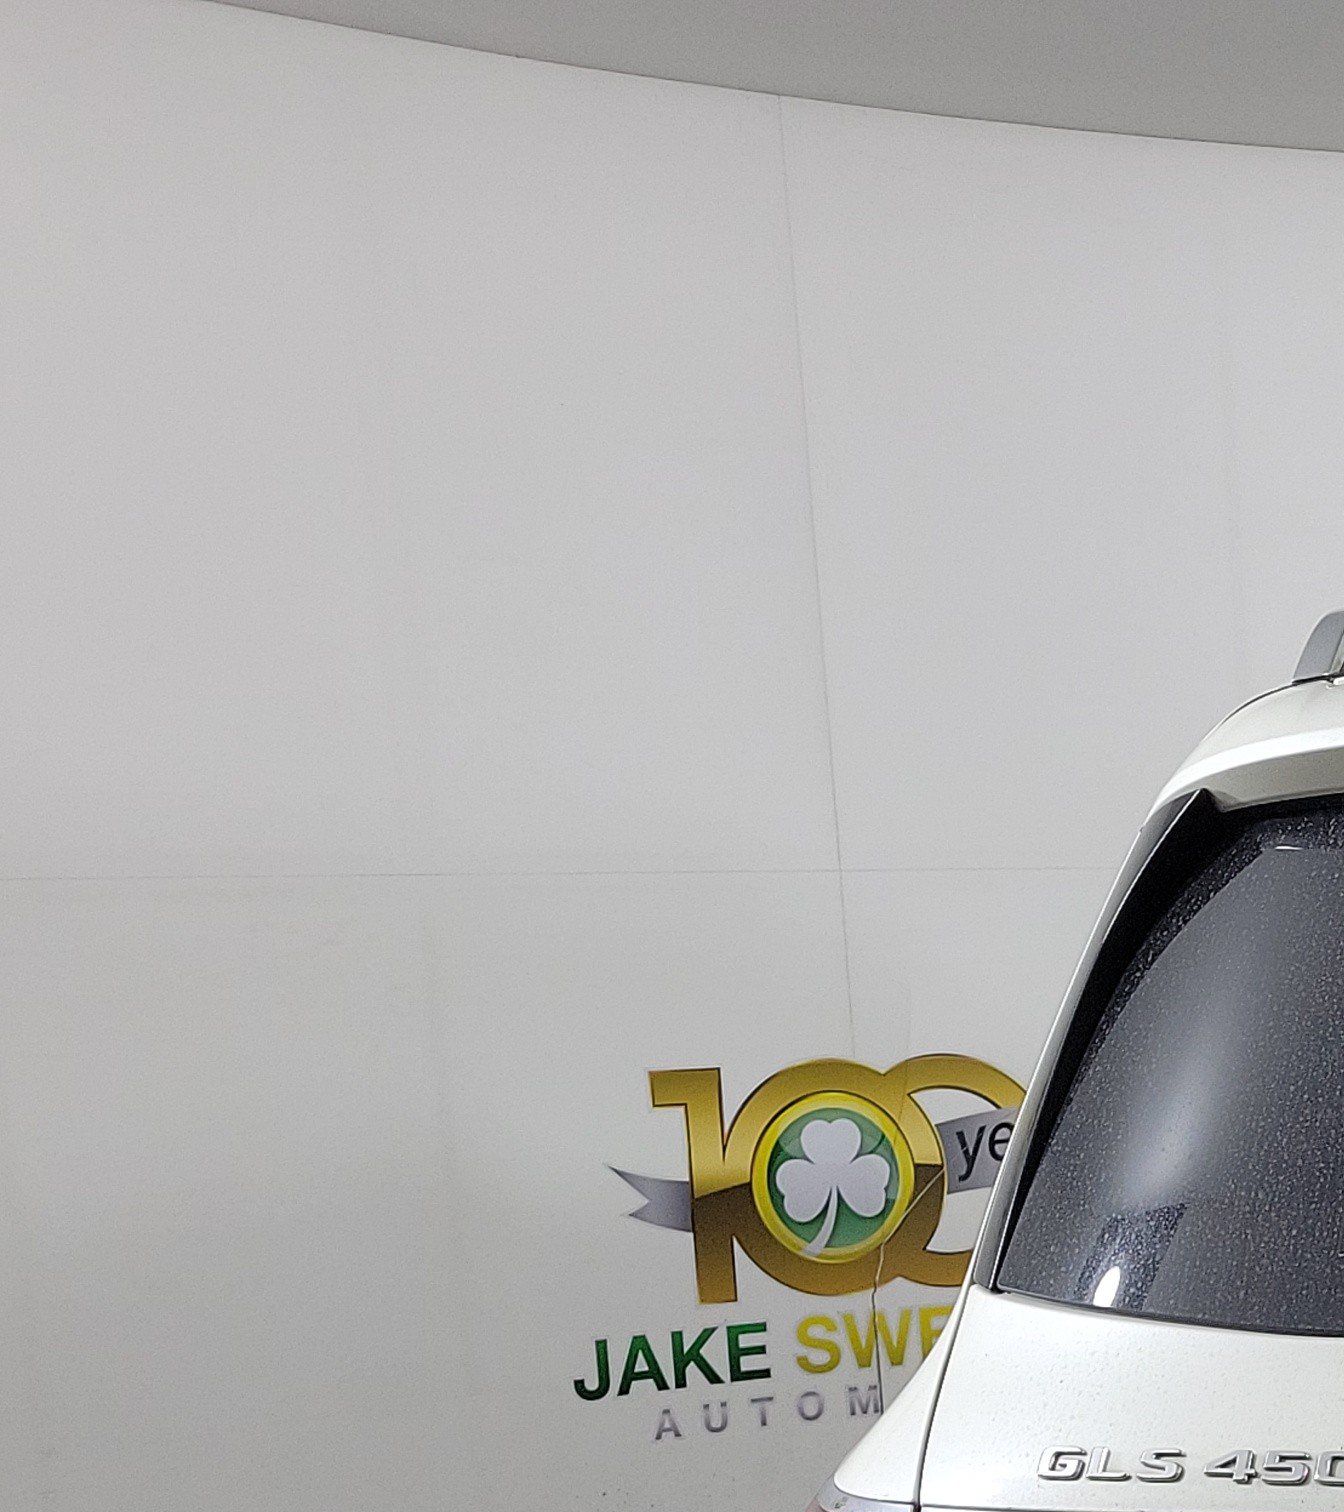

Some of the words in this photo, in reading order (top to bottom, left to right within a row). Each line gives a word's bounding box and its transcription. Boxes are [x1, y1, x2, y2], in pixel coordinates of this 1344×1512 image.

[648, 1053, 1027, 1304] 100
[573, 1321, 772, 1402] JAKE
[654, 1384, 881, 1442] AUTOM
[1037, 1446, 1187, 1483] GLS
